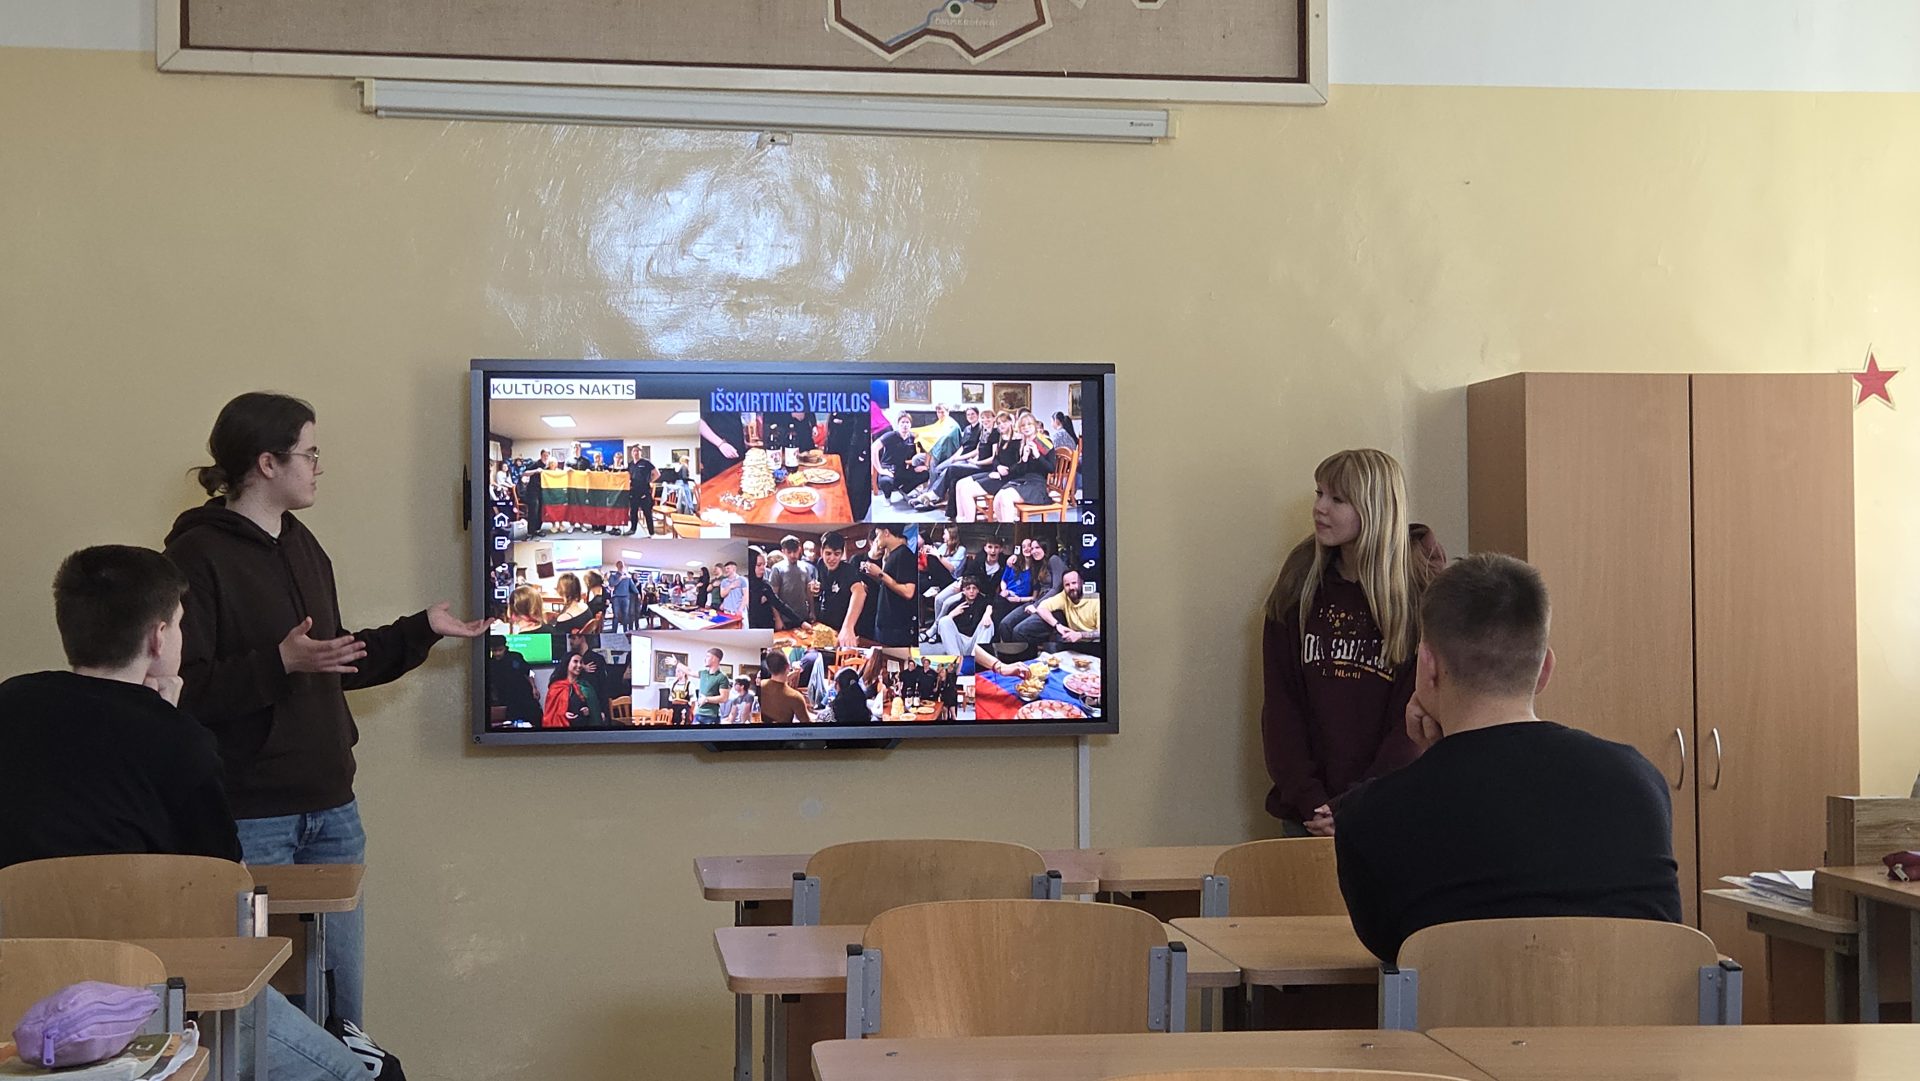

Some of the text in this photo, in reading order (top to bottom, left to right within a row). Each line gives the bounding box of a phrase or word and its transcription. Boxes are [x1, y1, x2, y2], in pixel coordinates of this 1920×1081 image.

[492, 380, 635, 396] KULTŪROS NAKTIS
[711, 388, 870, 412] IŠSKIRTINĖS VEIKLOS
